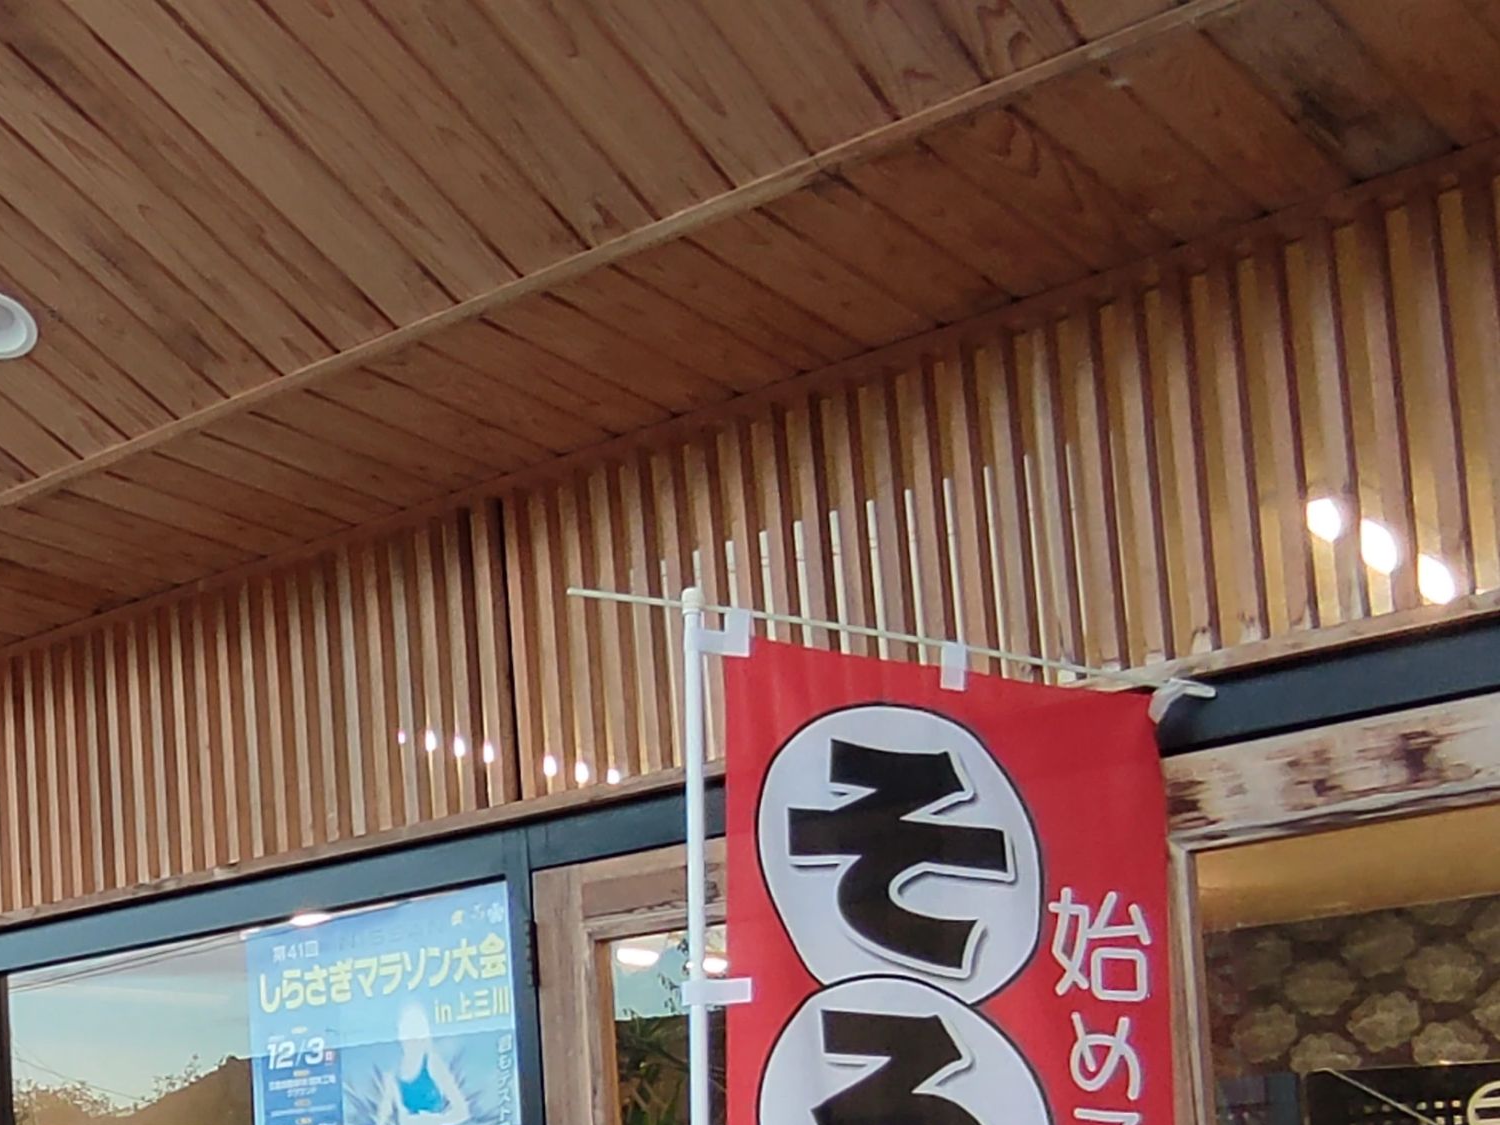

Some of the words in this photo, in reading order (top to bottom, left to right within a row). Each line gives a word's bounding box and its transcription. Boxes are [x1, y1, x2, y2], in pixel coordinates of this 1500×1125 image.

[259, 932, 508, 1014] しらさぎマラソン大会
[434, 999, 453, 1025] in
[455, 985, 510, 1023] 上三川
